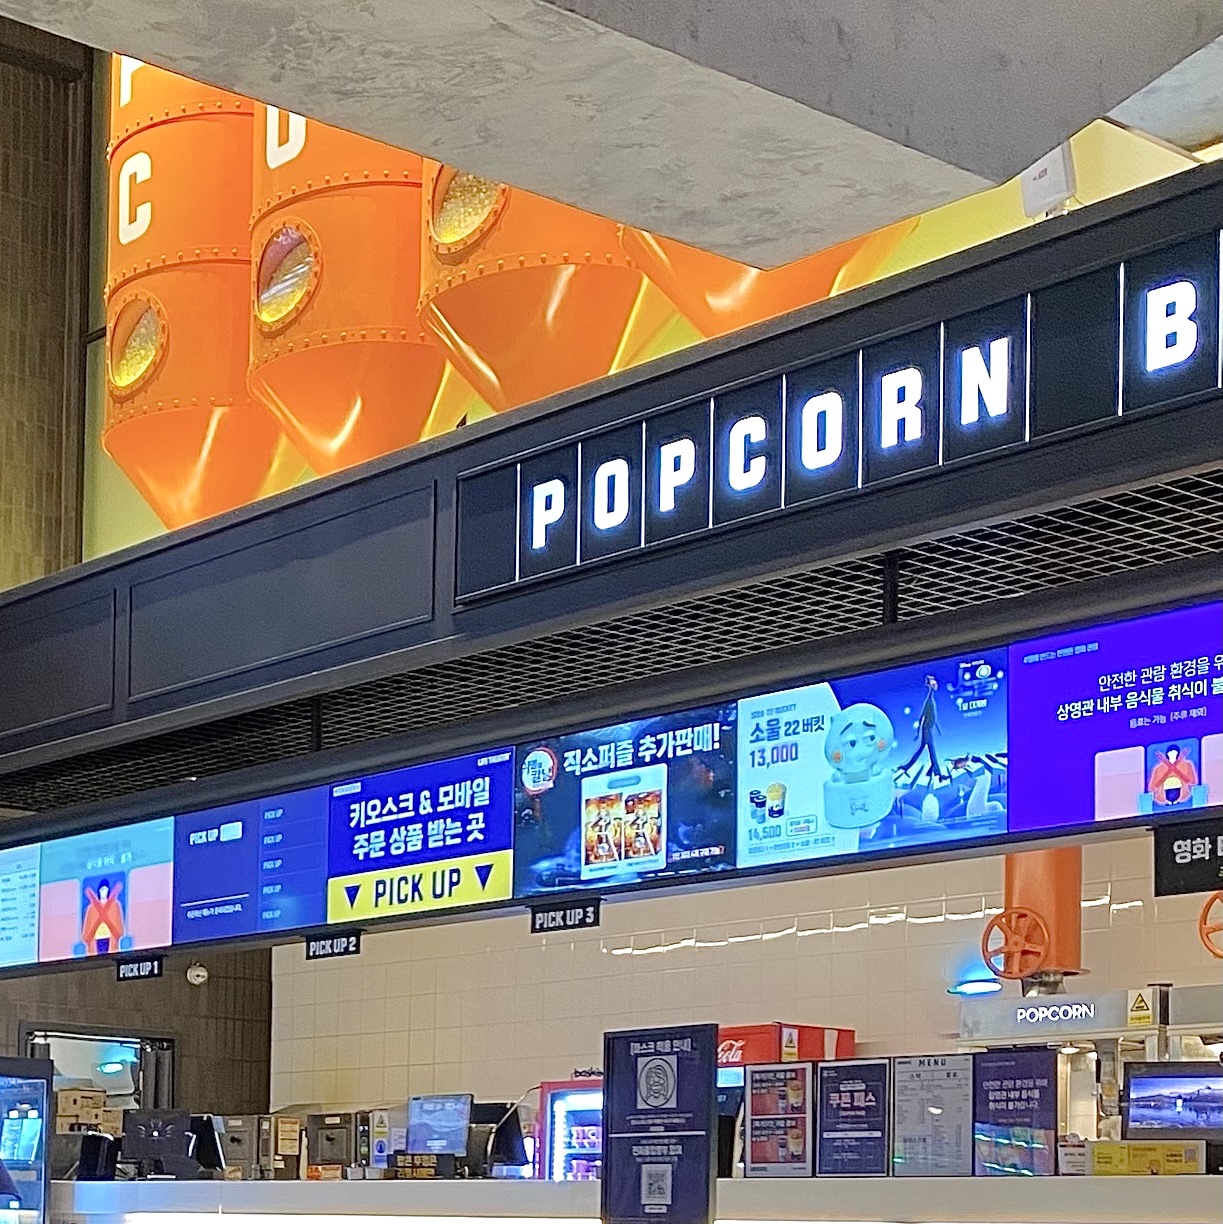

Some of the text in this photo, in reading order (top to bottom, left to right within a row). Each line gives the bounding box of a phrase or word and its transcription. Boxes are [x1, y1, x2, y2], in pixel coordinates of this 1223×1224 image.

[531, 336, 1010, 550] POPCORN
[1098, 669, 1137, 692] 안전한
[1140, 664, 1167, 685] 관람
[1170, 656, 1211, 679] 환경을
[1056, 698, 1095, 721] 상영관
[1096, 694, 1123, 714] 내부
[1125, 687, 1164, 710] 음식물
[1167, 678, 1208, 701] 취식이
[749, 714, 825, 744] 소울 22 버킷
[563, 740, 634, 776] 직소퍼즐
[637, 722, 721, 762] 추가판매!
[749, 742, 799, 769] 13,000
[349, 776, 491, 828] 키오스크 & 모바일
[352, 811, 486, 861] 주문 상품 받는 곳
[1172, 836, 1212, 864] 영화
[374, 867, 462, 908] PICK UP
[535, 906, 595, 929] PICK UP 3
[309, 936, 357, 957] PICK UP 2
[119, 960, 159, 978] PICK UP 1
[1017, 1003, 1095, 1023] POPCORN
[919, 1058, 947, 1067] MENU
